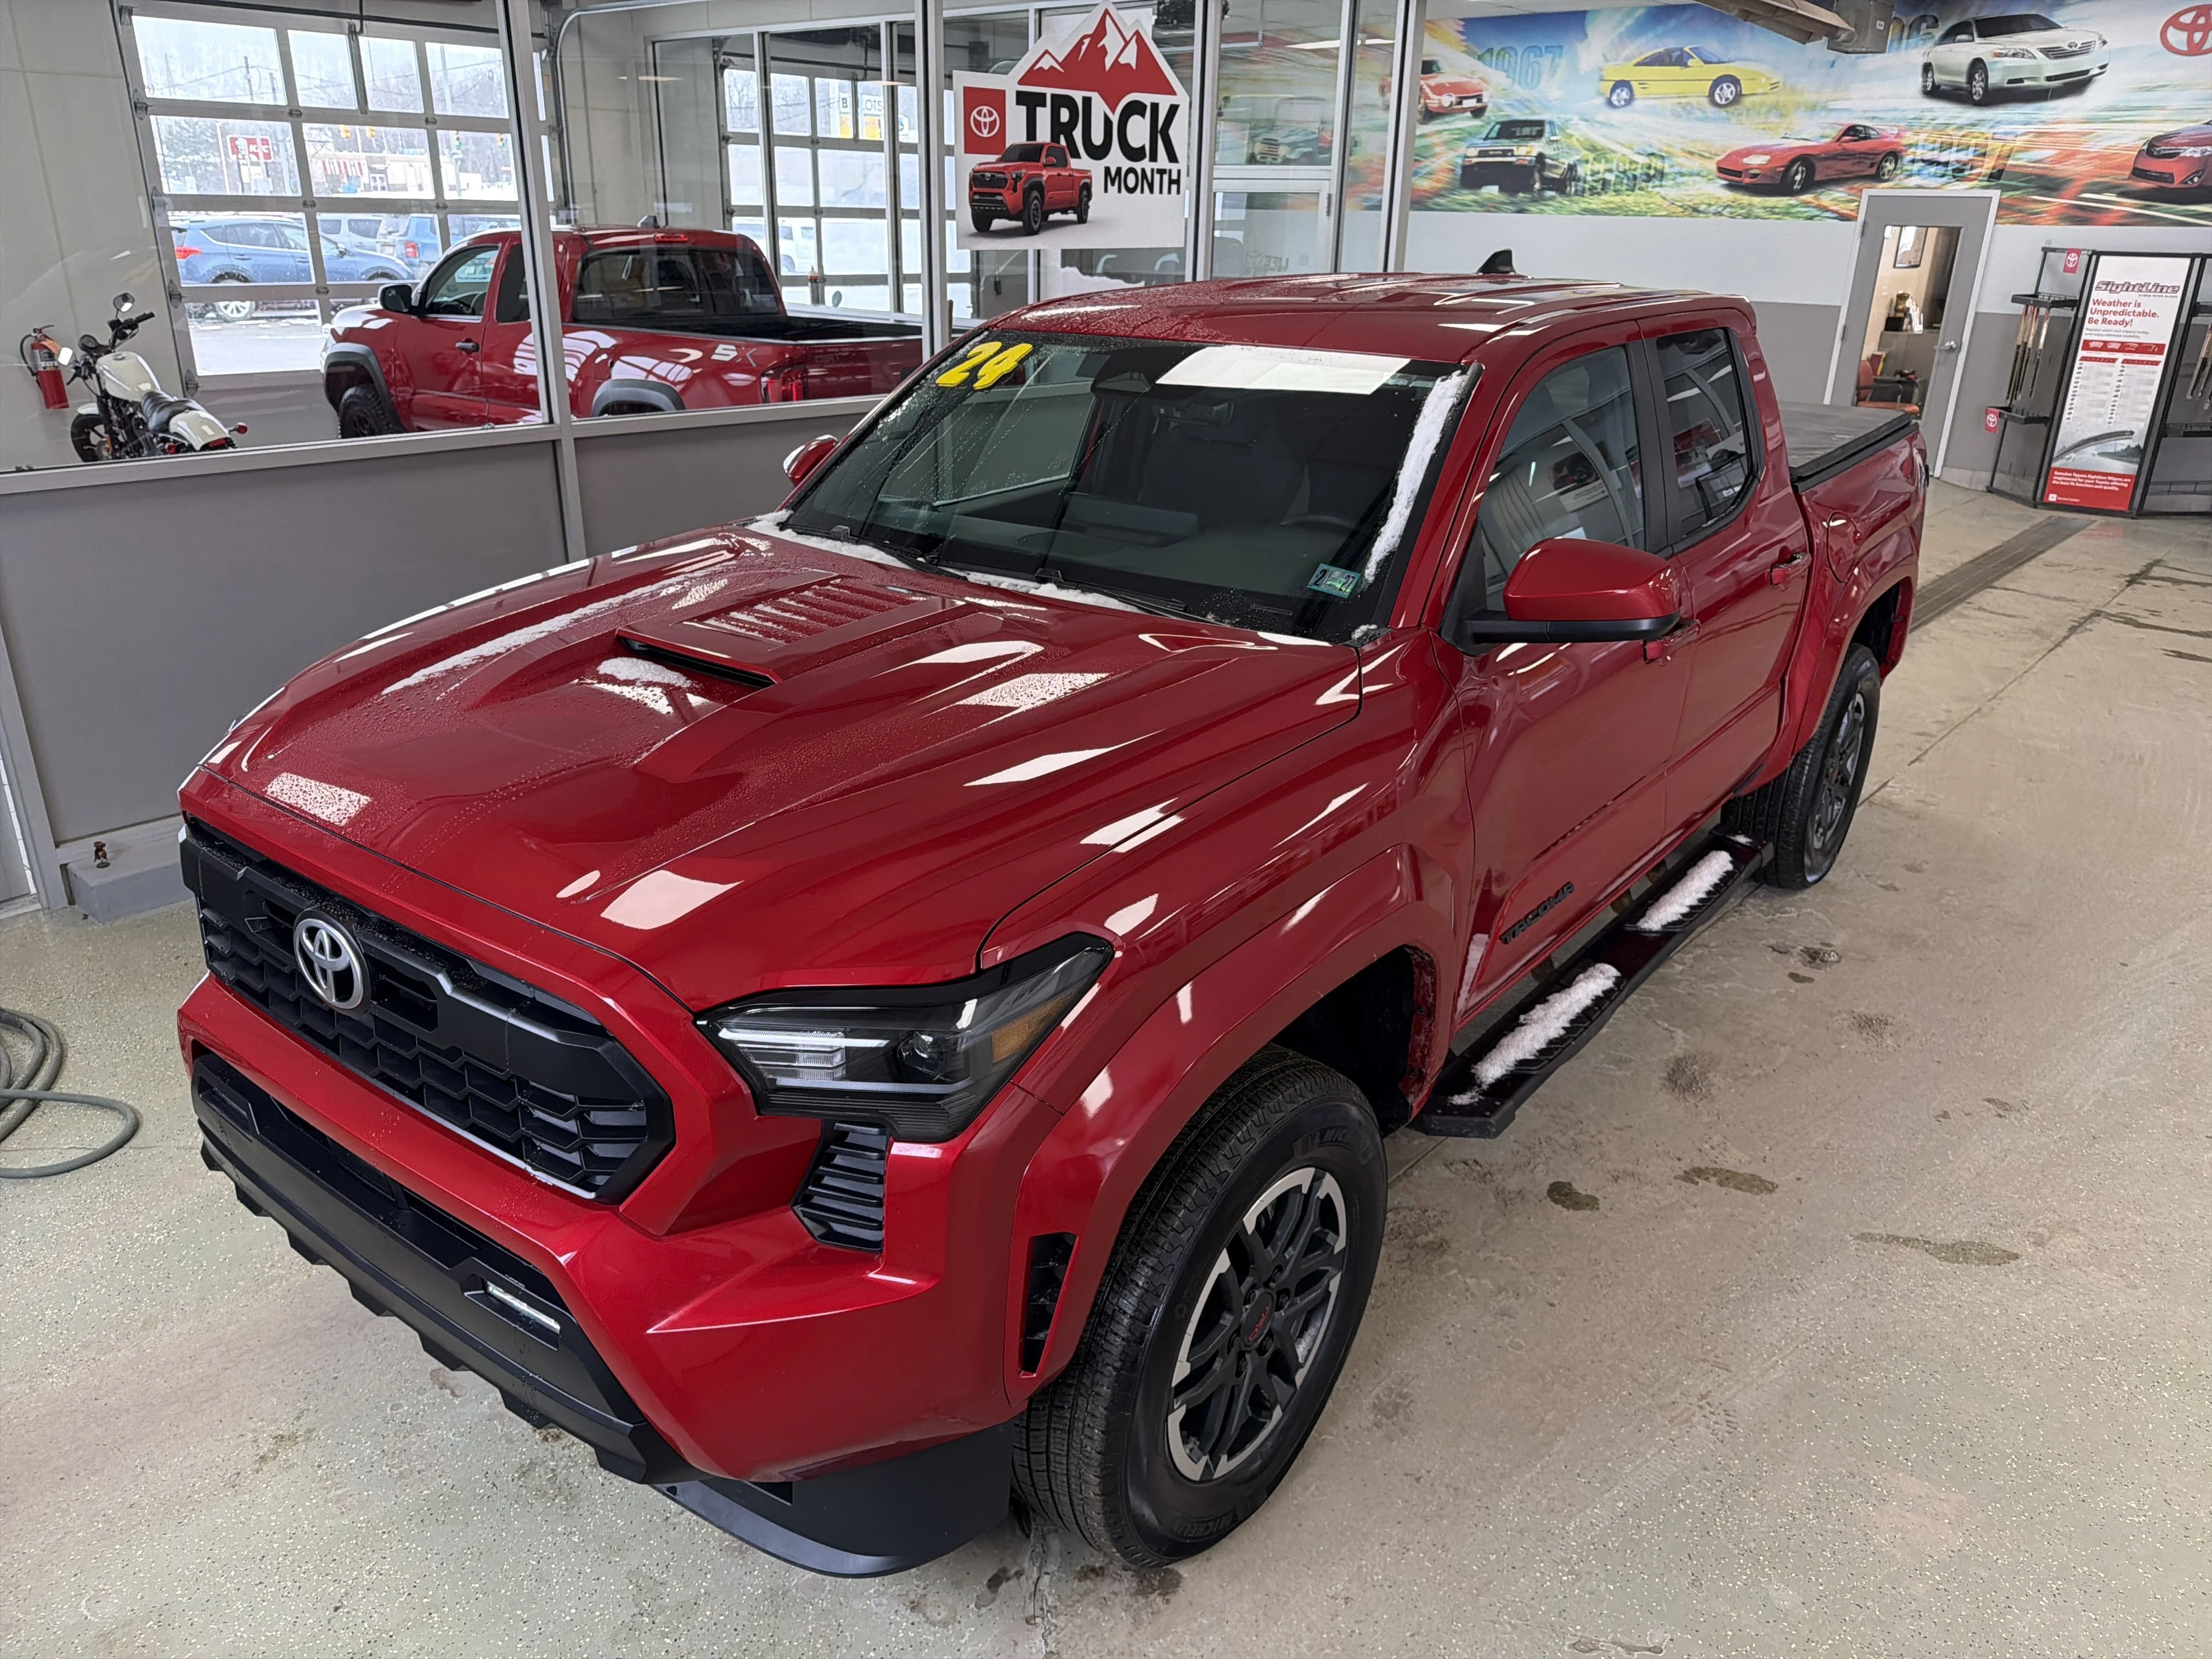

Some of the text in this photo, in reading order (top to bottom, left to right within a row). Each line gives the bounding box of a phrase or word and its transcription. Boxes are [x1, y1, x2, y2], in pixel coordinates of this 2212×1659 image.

[1477, 45, 1565, 91] 1967
[1015, 89, 1181, 163] TRUCK
[249, 144, 269, 153] KC
[1104, 166, 1181, 195] MONTH
[2095, 280, 2181, 294] SightLine
[2090, 308, 2159, 318] Unpredictable.
[2092, 298, 2132, 308] Weather
[2087, 317, 2133, 328] Be Ready!
[935, 341, 1034, 390] 24
[1313, 569, 1356, 592] 2 27
[1498, 881, 1575, 945] TACOMA
